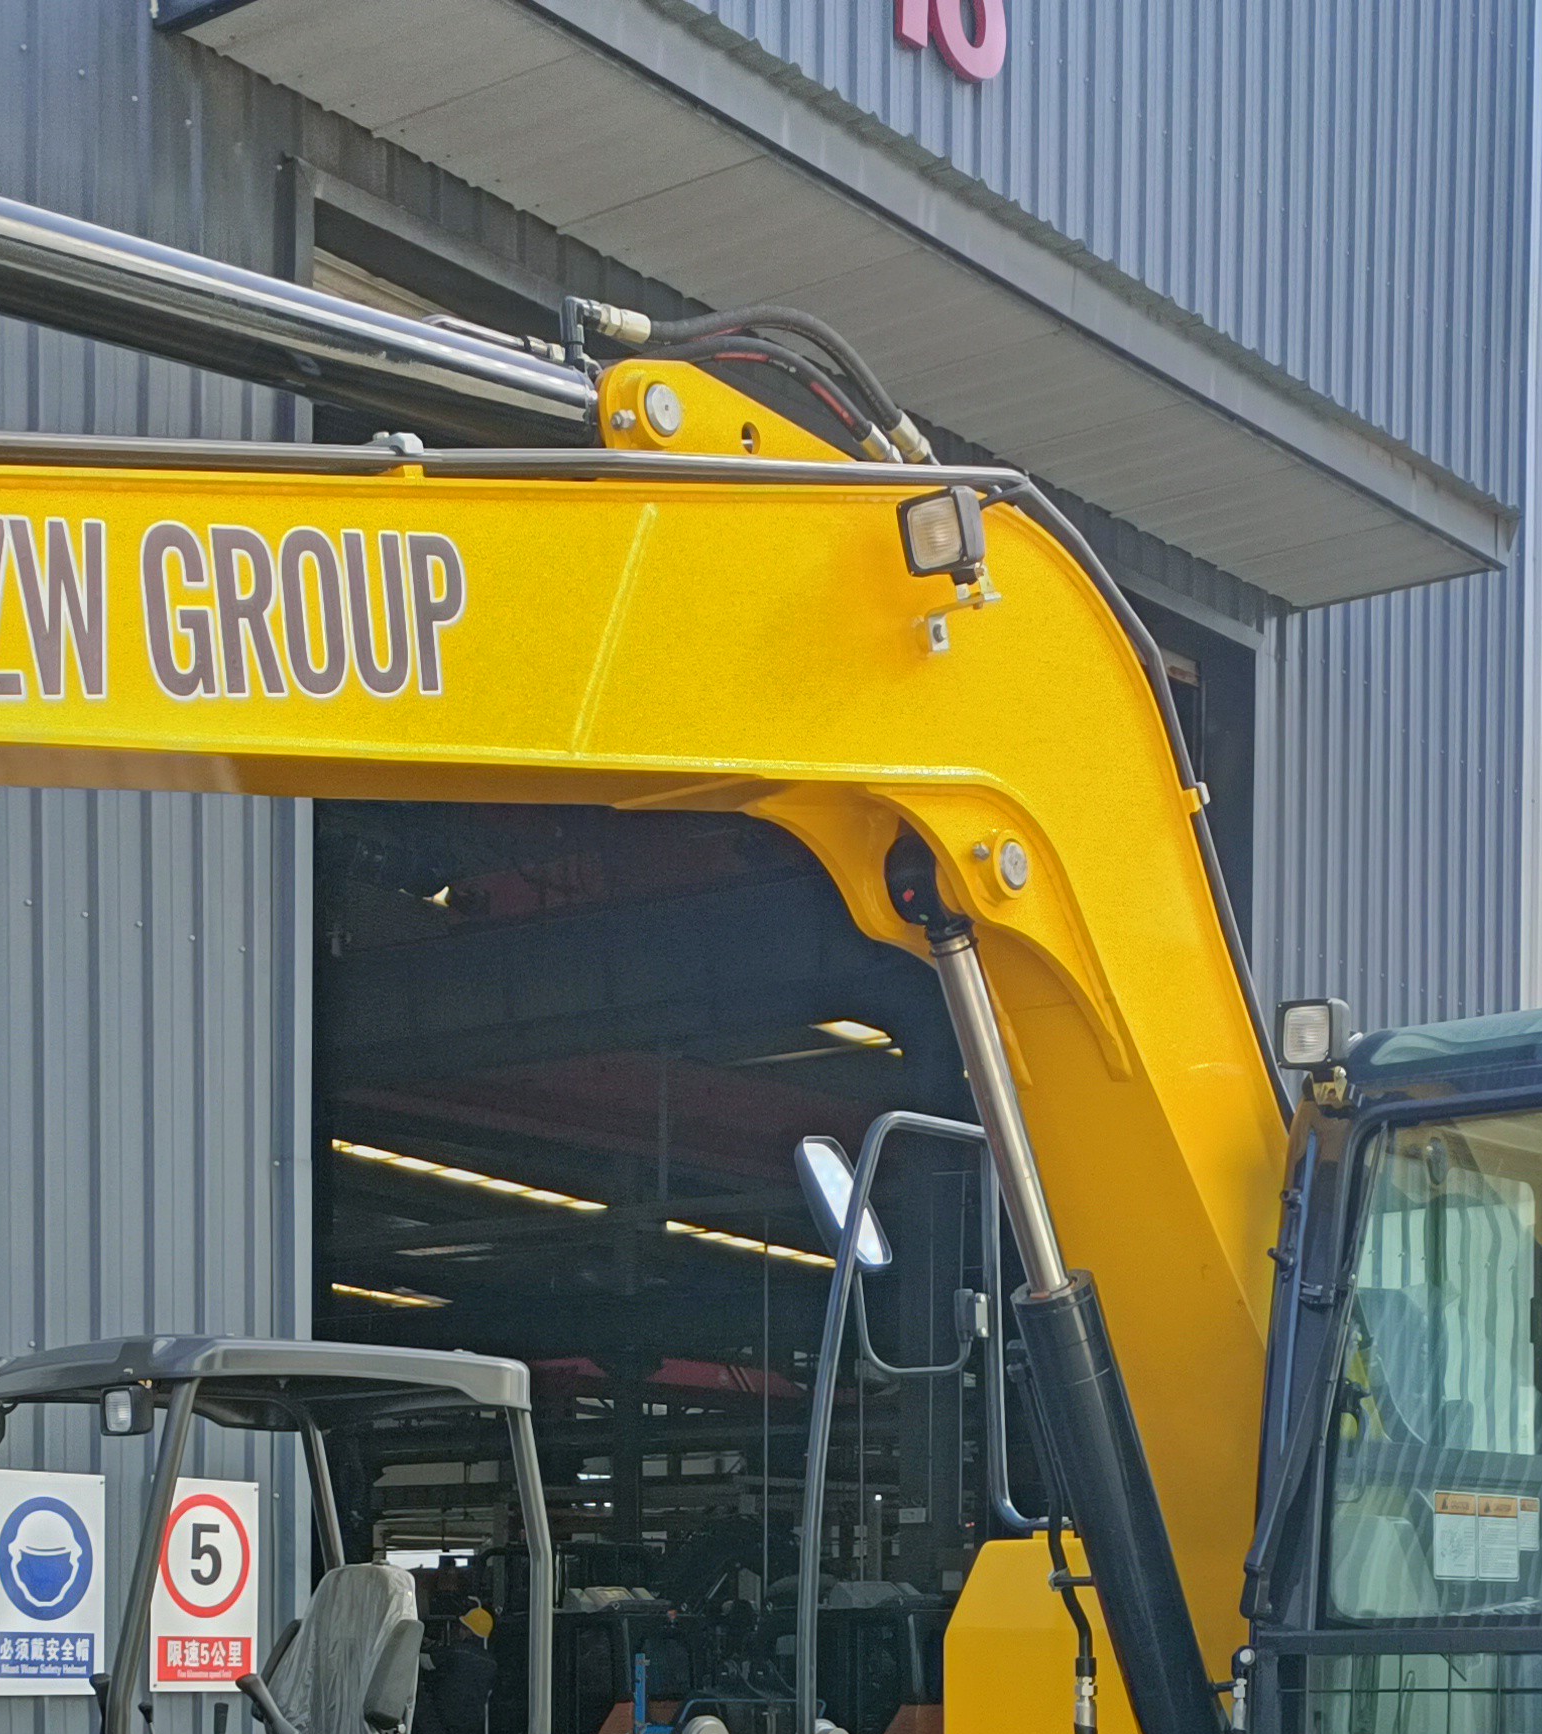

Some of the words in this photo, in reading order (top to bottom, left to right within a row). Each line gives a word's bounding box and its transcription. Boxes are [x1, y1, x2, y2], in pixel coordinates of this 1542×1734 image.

[140, 520, 466, 700] GROUP
[190, 1523, 222, 1586] 5
[0, 1638, 89, 1661] 必须戴安全帽
[167, 1640, 242, 1667] 限速5公里
